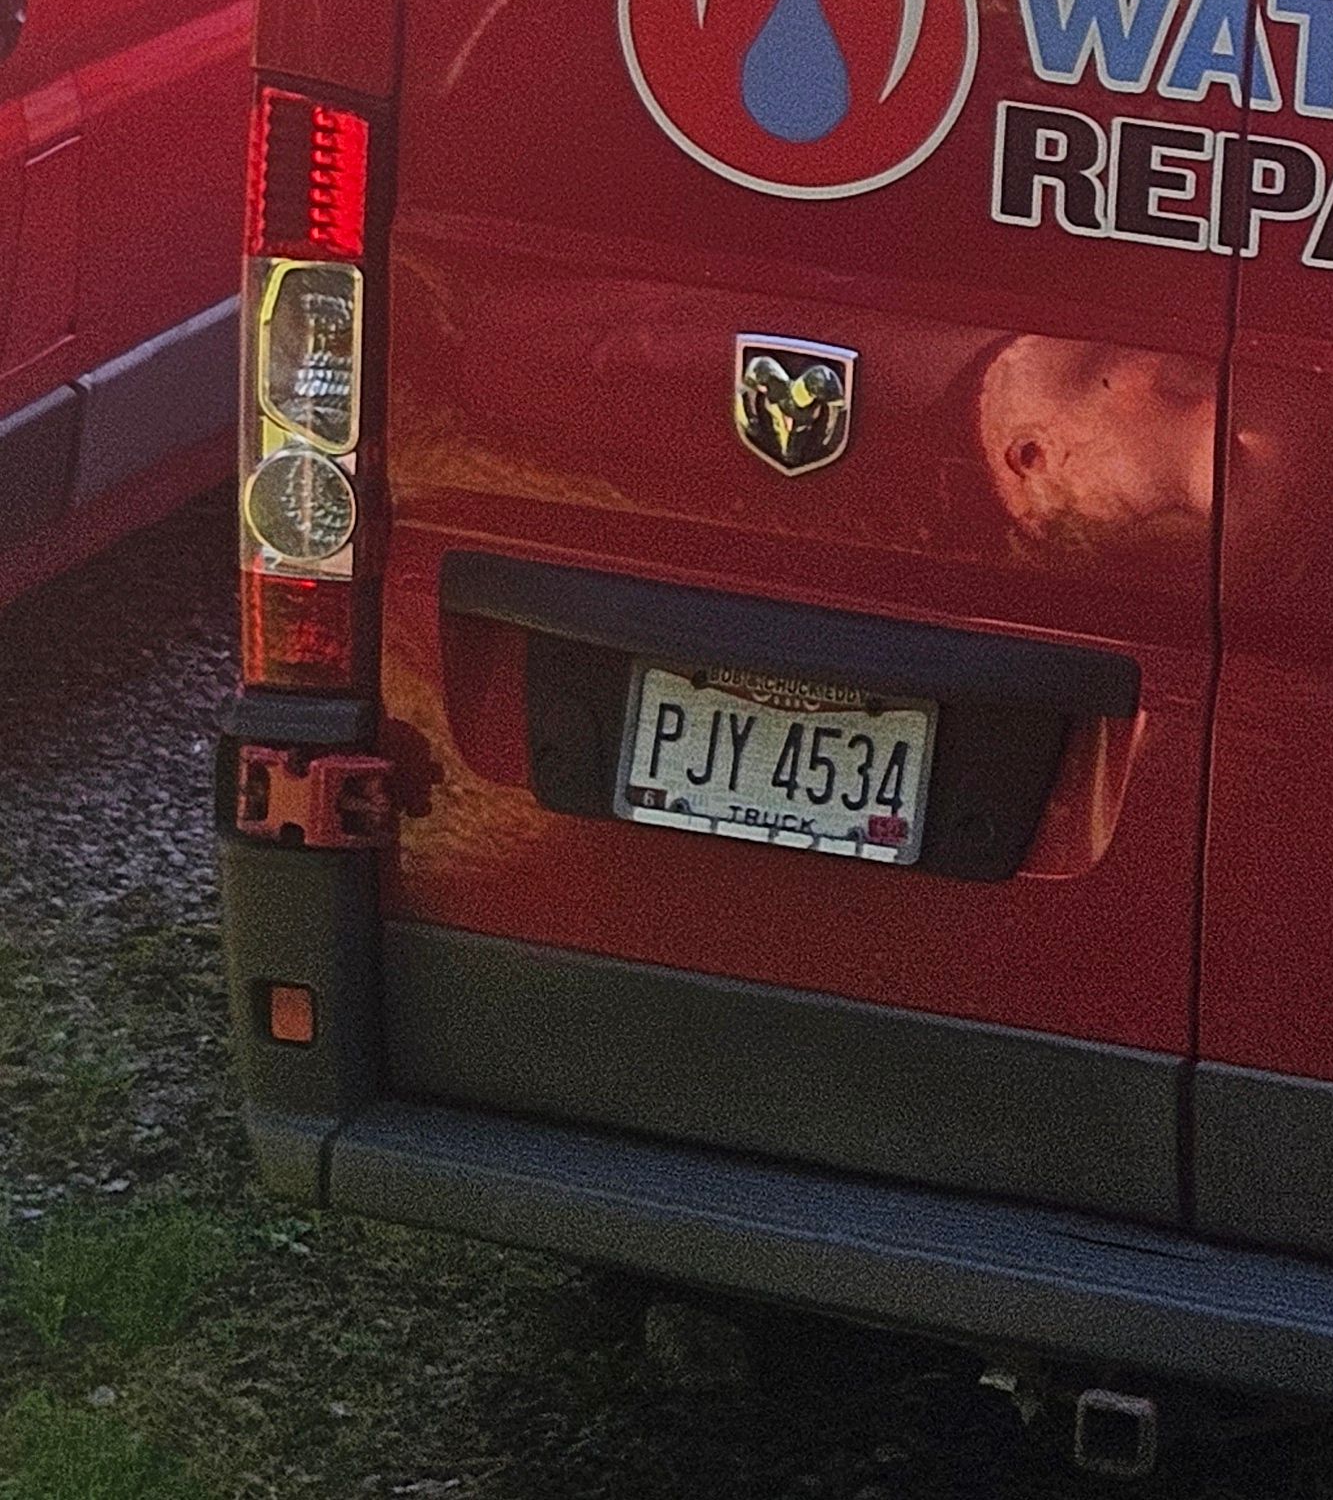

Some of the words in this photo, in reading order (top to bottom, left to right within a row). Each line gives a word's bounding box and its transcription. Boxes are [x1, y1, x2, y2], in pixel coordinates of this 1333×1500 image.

[648, 702, 758, 792] PJY
[771, 721, 910, 815] 4534
[727, 804, 818, 833] TRUCK
